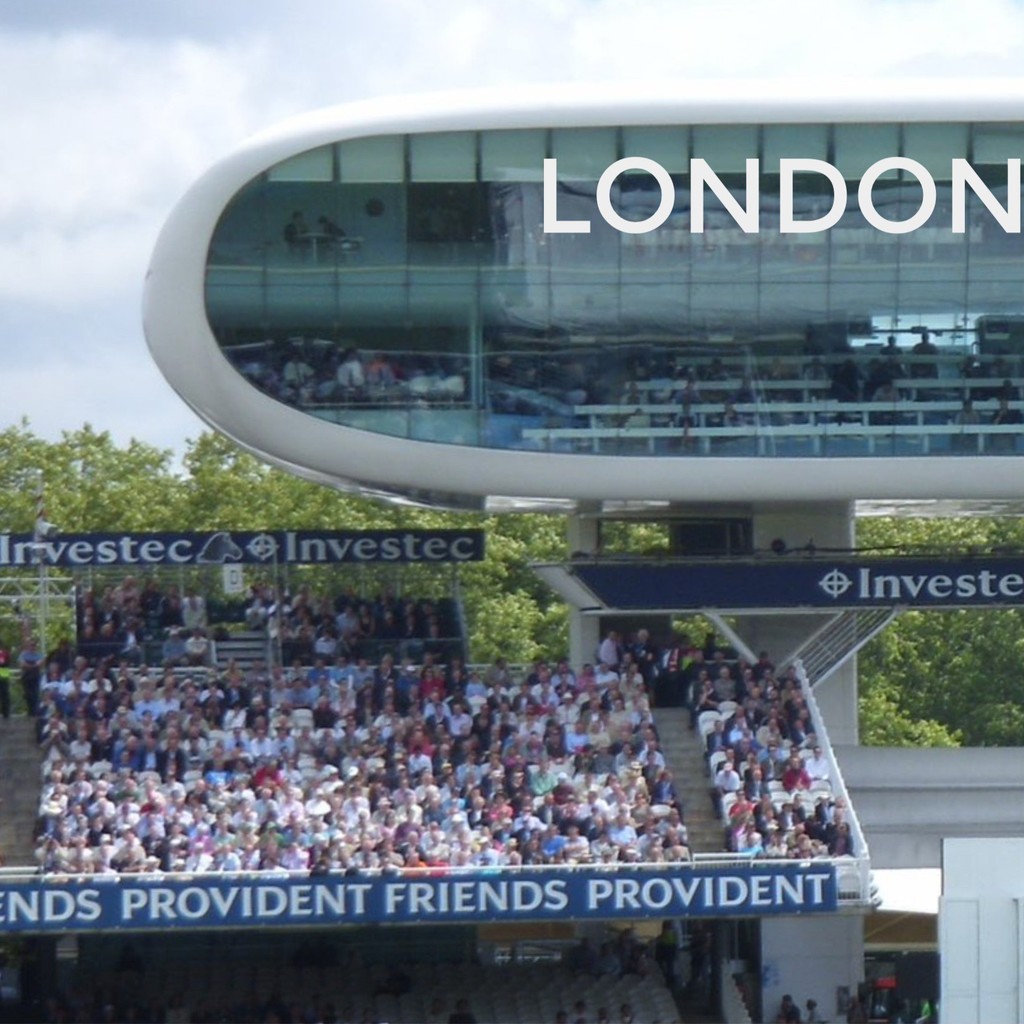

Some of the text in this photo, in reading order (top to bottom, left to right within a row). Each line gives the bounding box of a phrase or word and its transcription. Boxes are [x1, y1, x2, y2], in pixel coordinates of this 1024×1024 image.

[0, 534, 193, 564] Investec
[286, 532, 474, 561] Investec
[121, 884, 372, 919] PROVIDENT
[386, 880, 568, 913] FRIENDS
[589, 874, 831, 909] PROVIDENT
